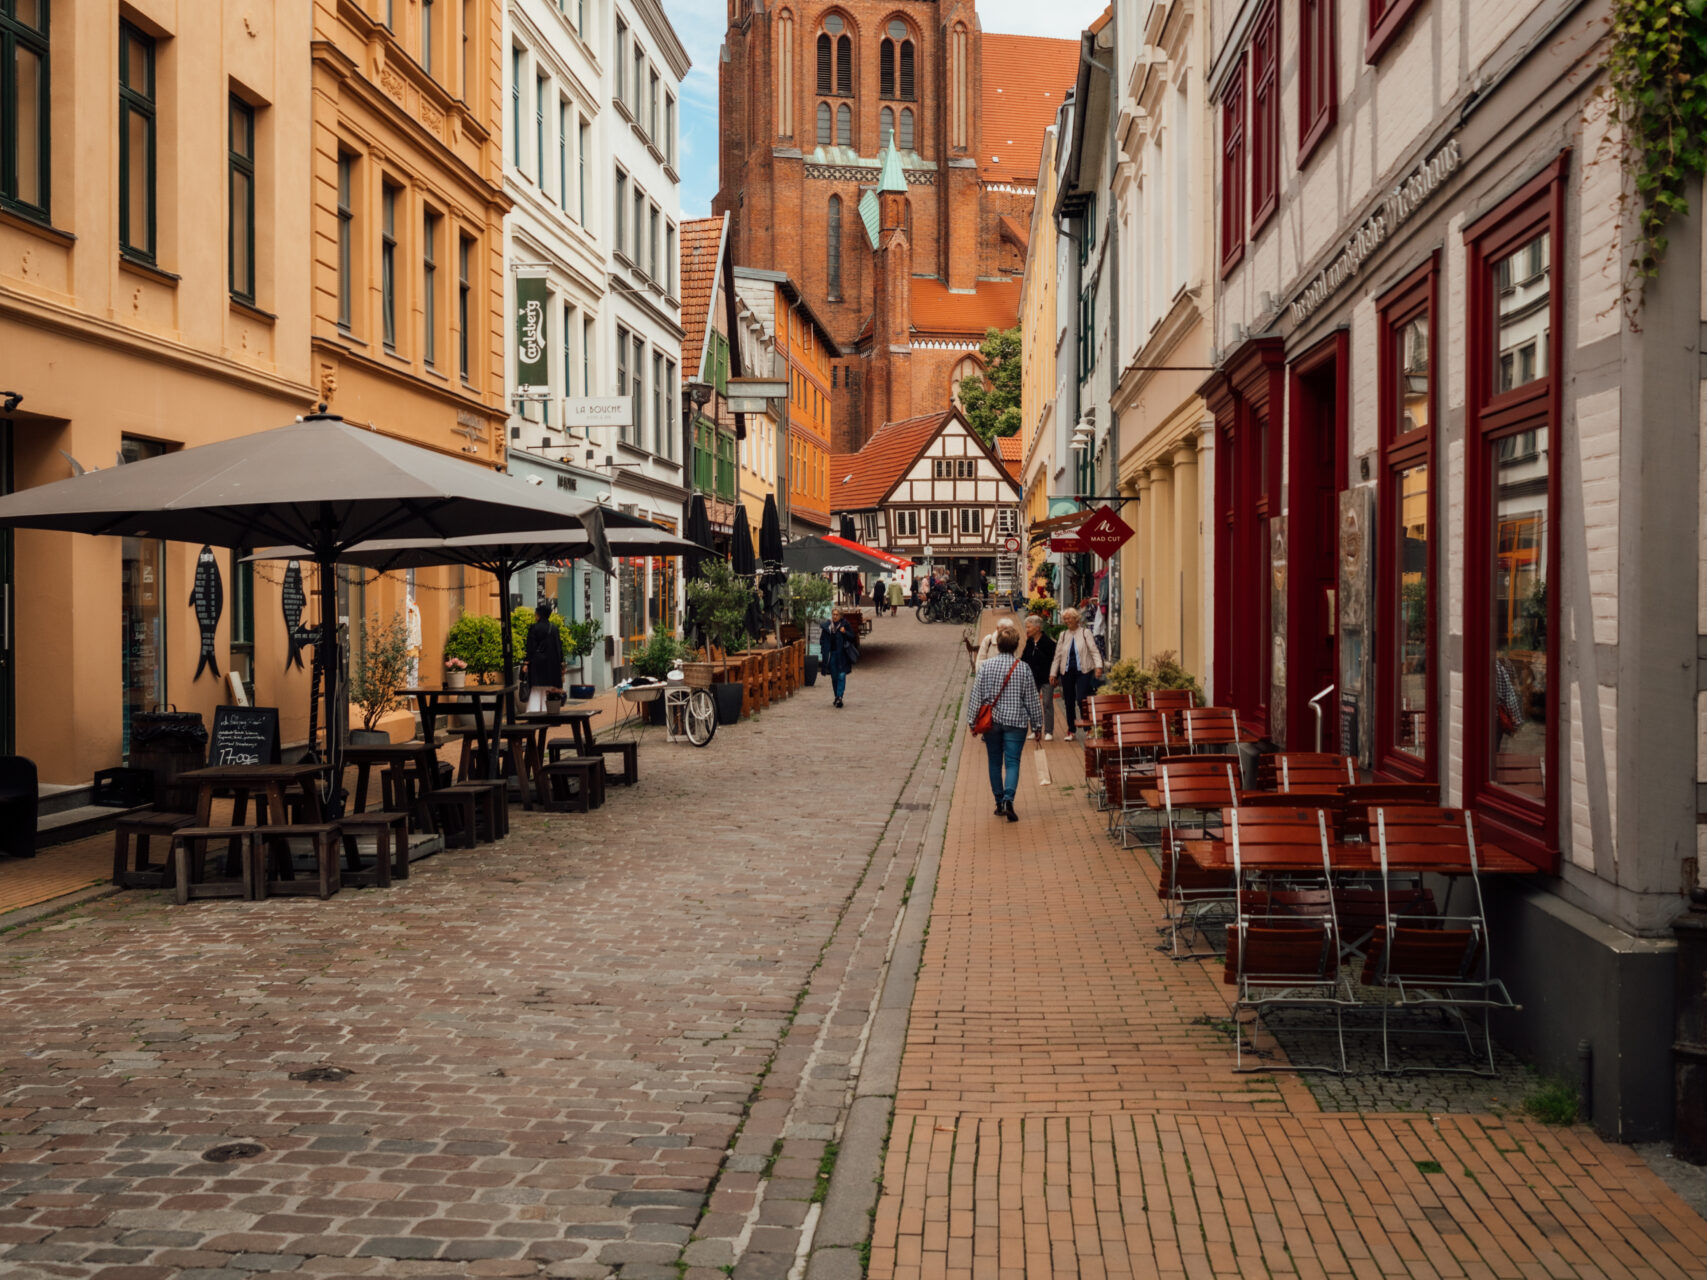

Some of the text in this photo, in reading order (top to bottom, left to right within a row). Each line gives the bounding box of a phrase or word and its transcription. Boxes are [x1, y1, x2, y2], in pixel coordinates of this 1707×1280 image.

[1383, 138, 1459, 232] Wirtshaus
[519, 300, 546, 364] Carlsberg
[575, 405, 622, 414] LA BOUCHE
